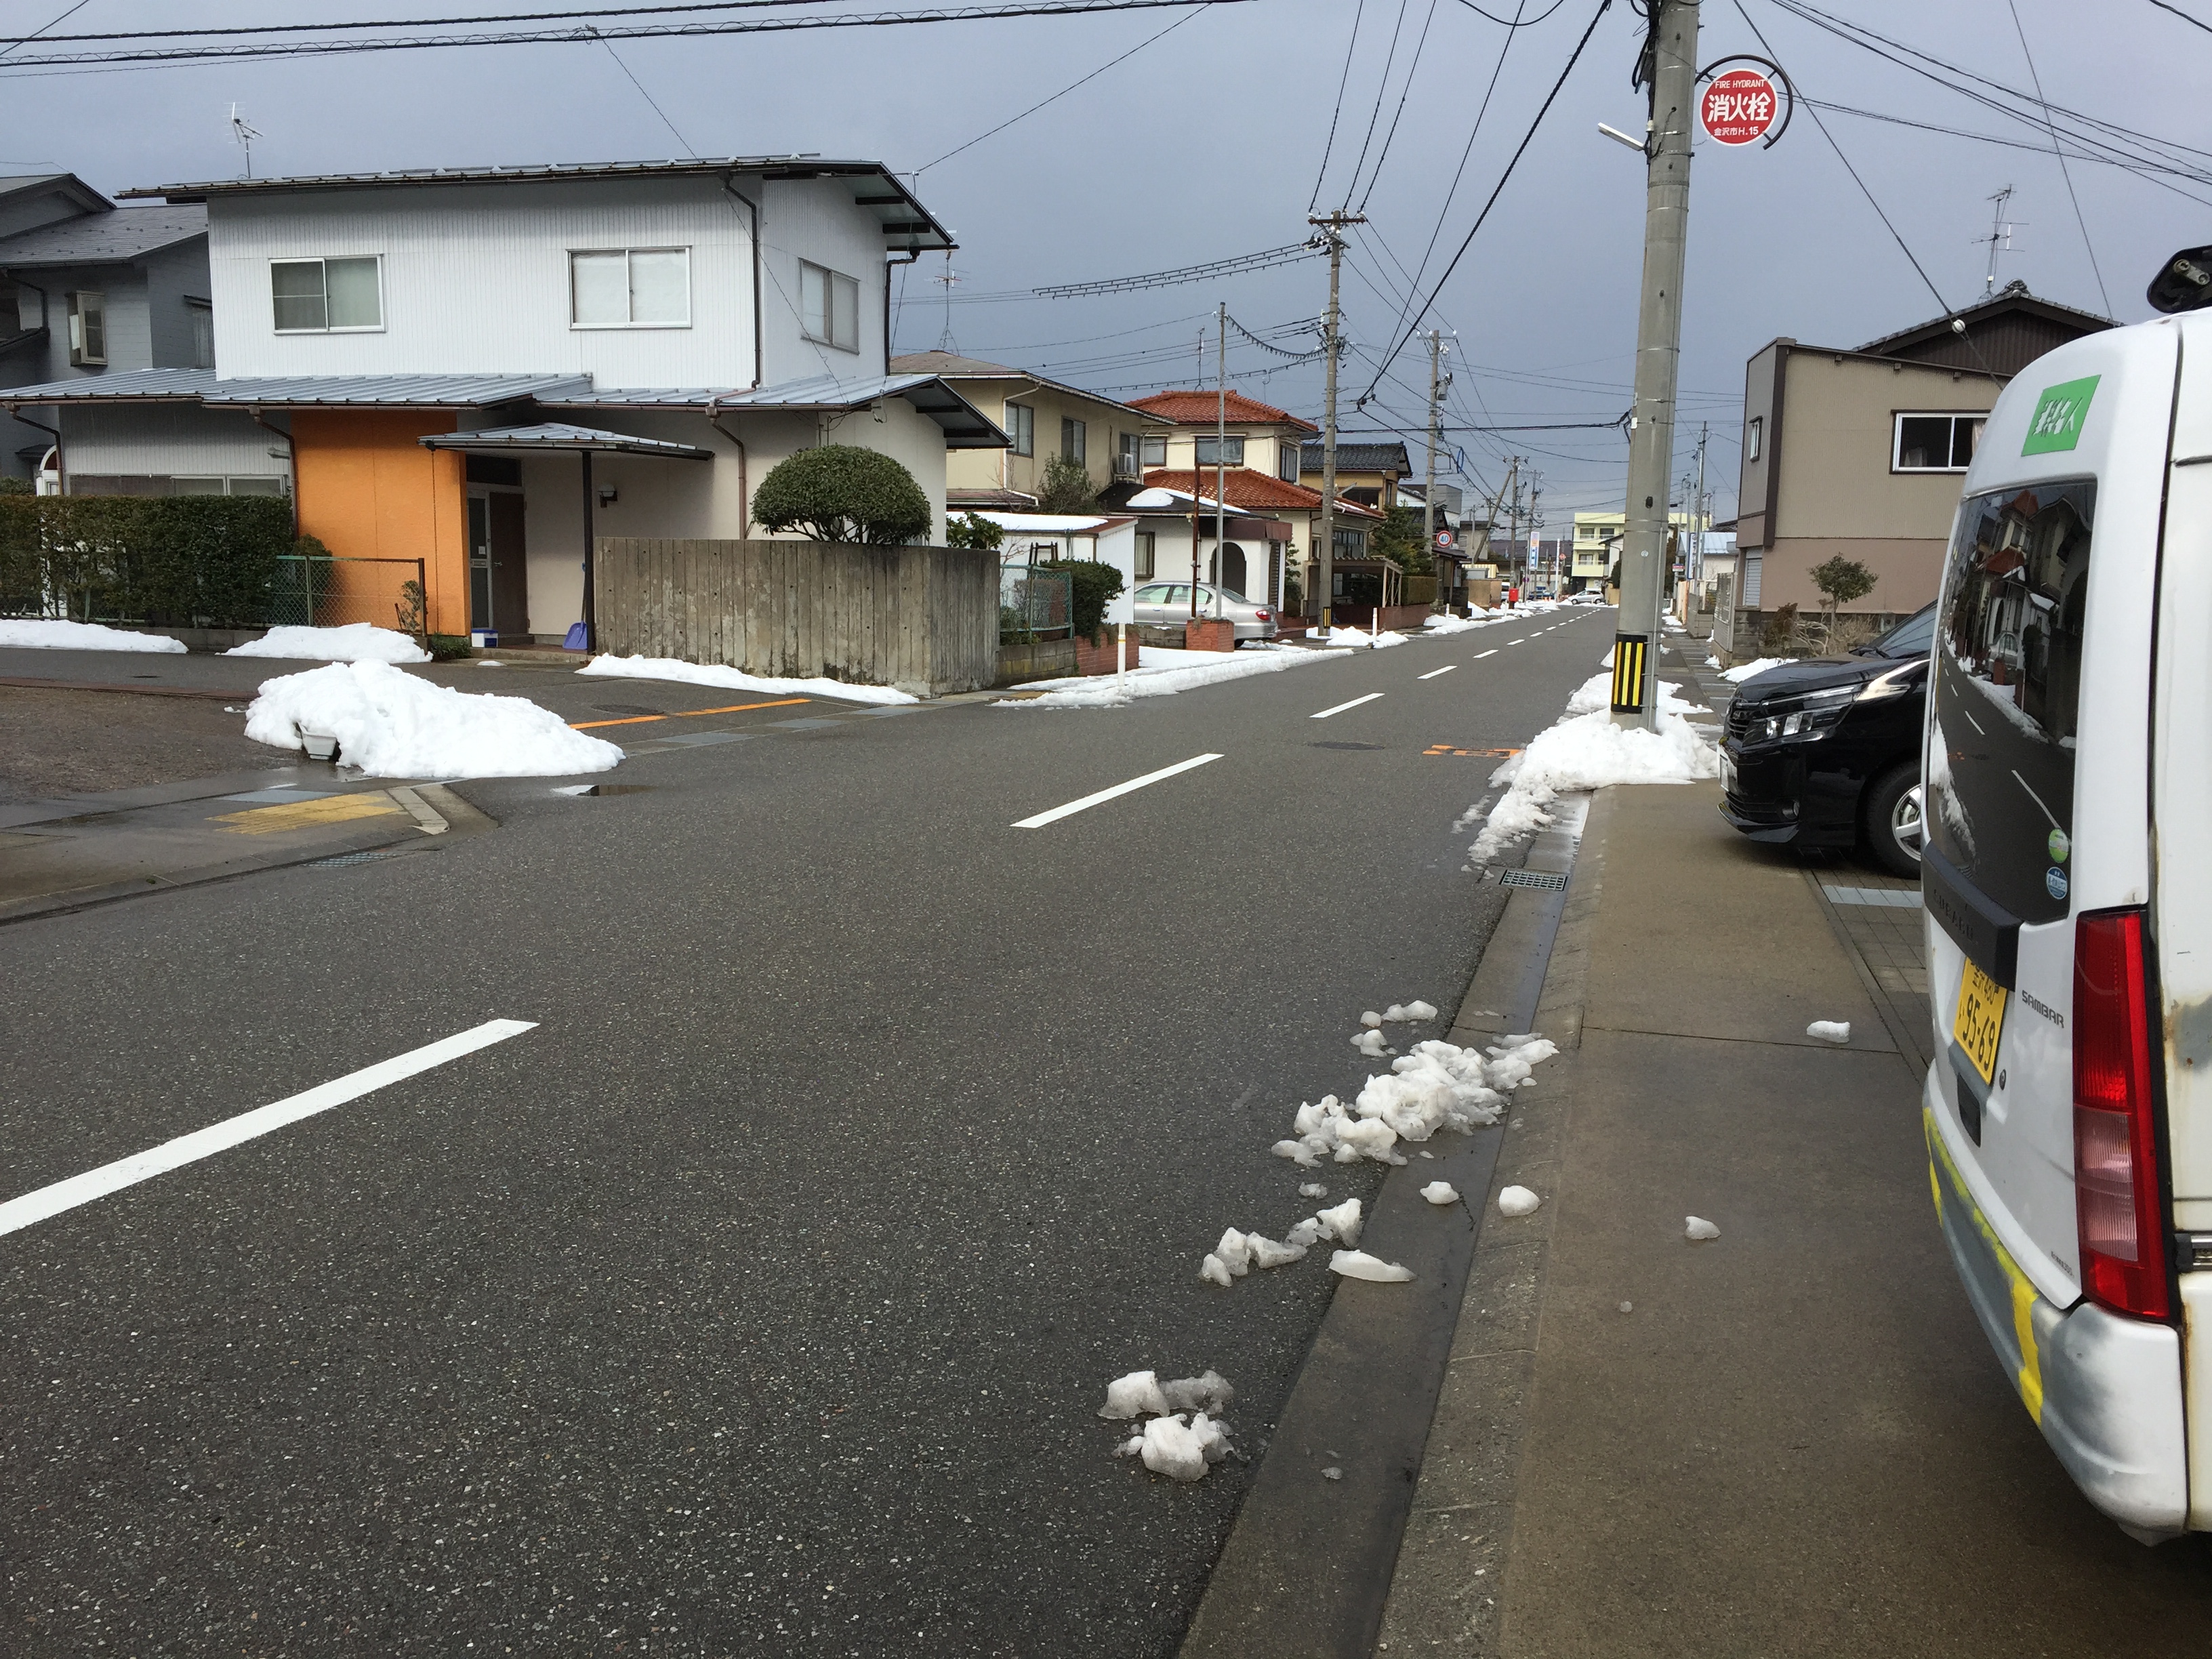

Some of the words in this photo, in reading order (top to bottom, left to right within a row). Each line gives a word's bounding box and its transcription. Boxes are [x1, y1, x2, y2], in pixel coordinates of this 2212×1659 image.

[1715, 81, 1730, 89] FIRE
[1732, 79, 1765, 88] HYDRANT
[1707, 91, 1771, 123] 消火栓
[2022, 989, 2065, 1029] SAMBAR
[1963, 993, 1996, 1071] 95-69
